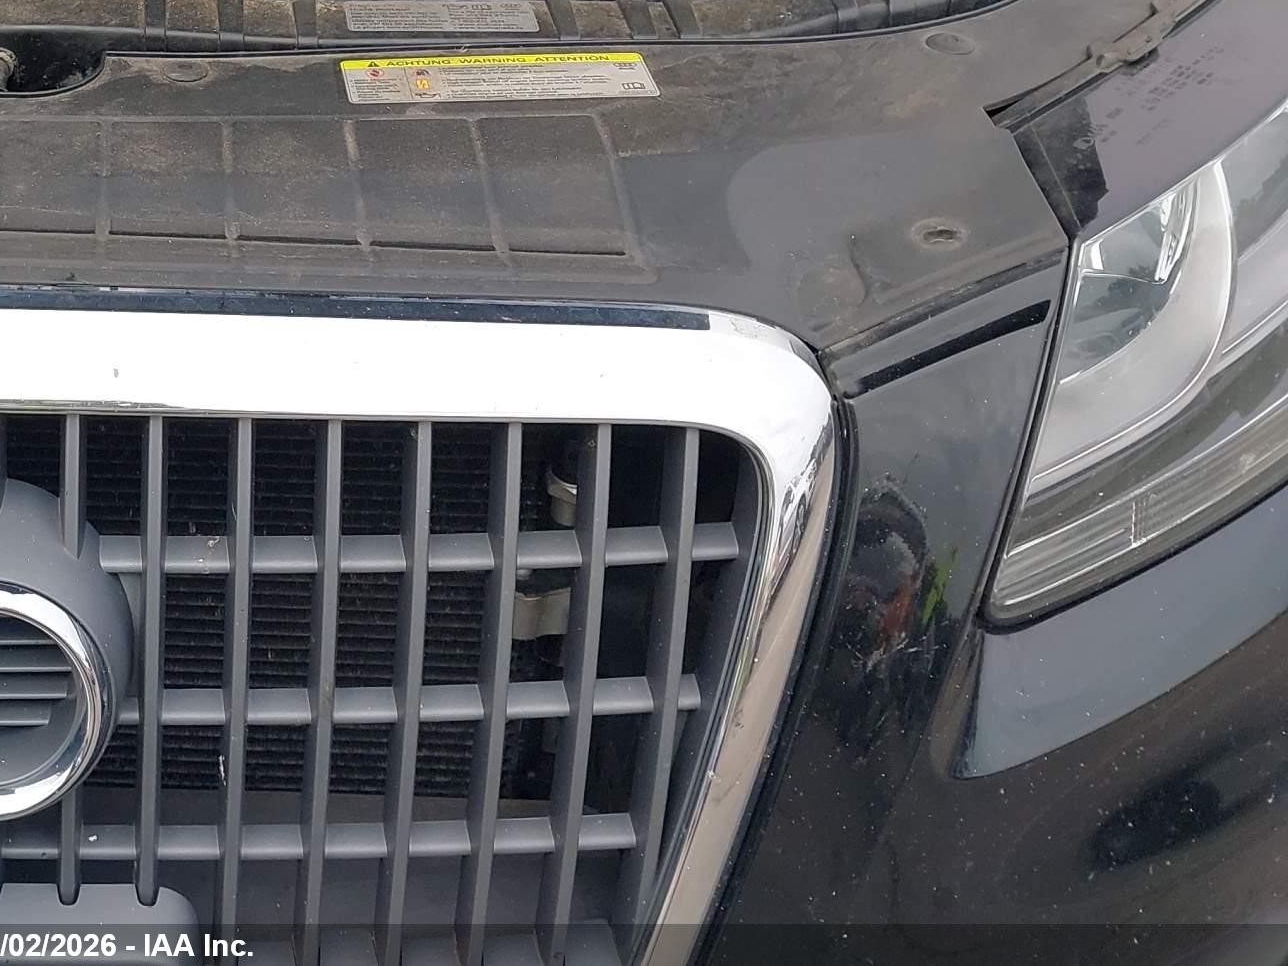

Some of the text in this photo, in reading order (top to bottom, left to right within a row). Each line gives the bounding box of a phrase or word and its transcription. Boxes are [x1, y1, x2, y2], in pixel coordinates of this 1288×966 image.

[386, 54, 610, 67] ACHTUNG WARNING ATTENTION
